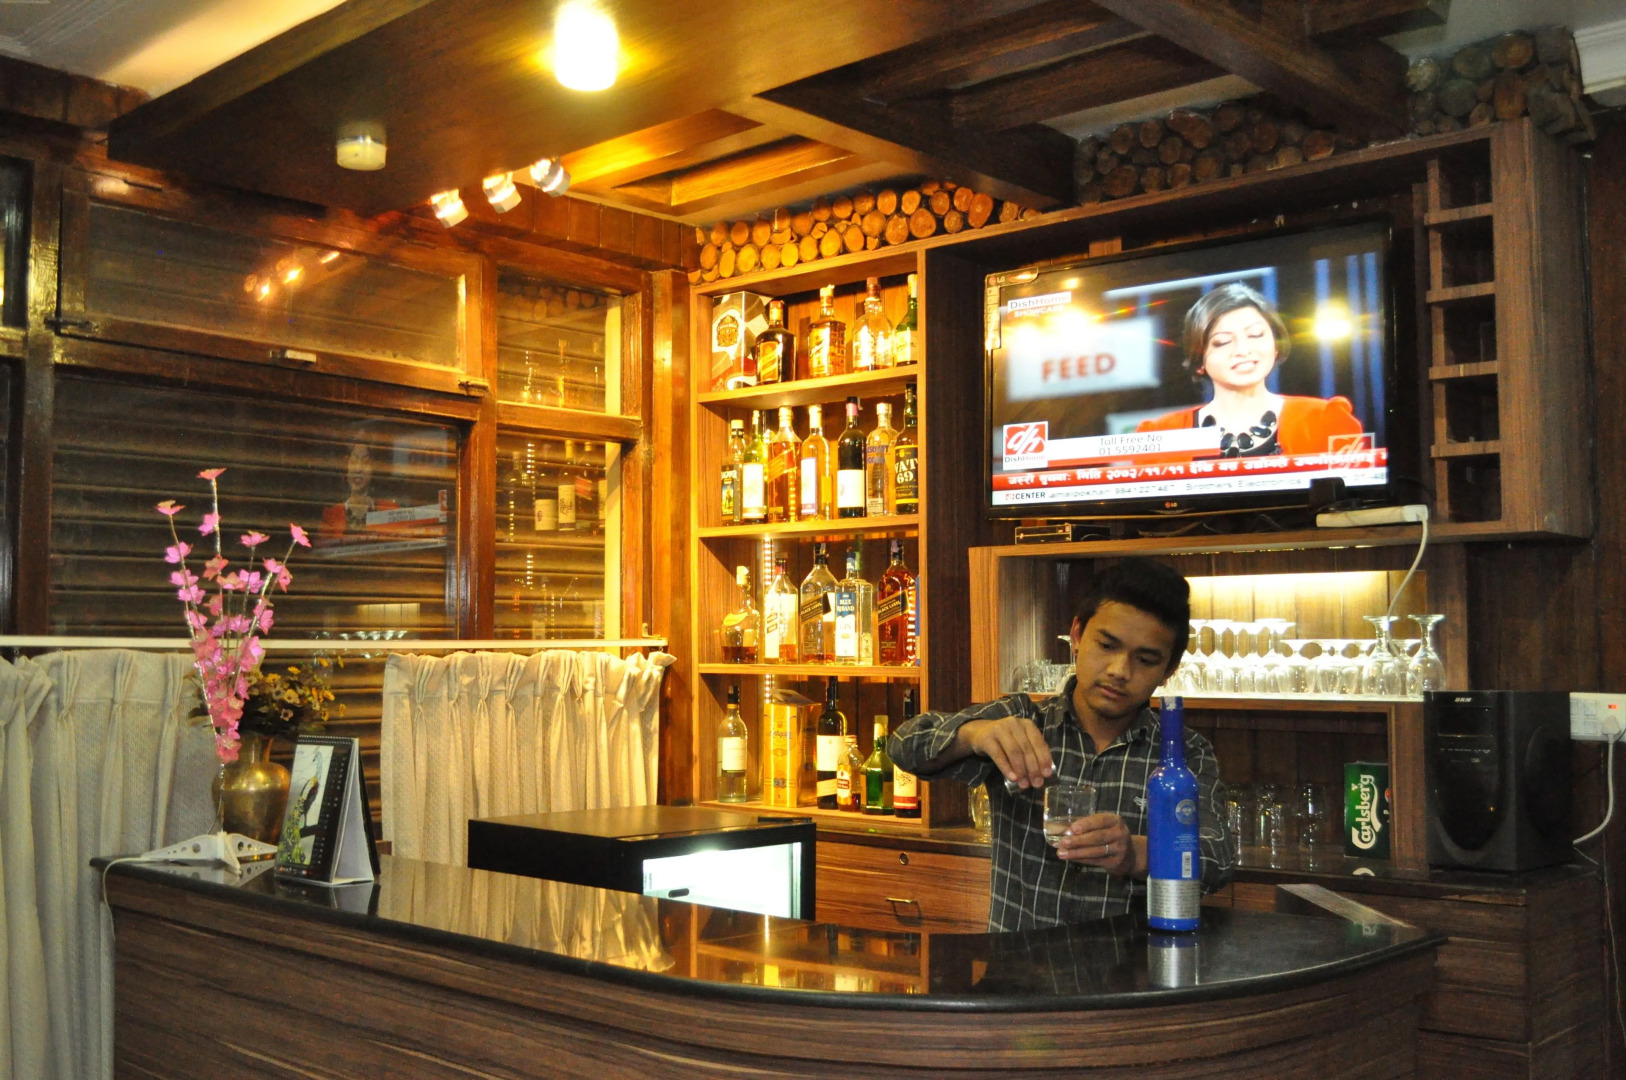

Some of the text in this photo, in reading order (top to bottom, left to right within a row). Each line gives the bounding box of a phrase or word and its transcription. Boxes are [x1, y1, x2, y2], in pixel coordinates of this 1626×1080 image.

[1041, 353, 1116, 382] FEED
[1100, 434, 1163, 447] Toll Free No
[1099, 443, 1162, 456] 01 5592401
[896, 470, 914, 484] 69
[1015, 491, 1046, 500] CENTER
[1351, 774, 1382, 850] Carlsberg
